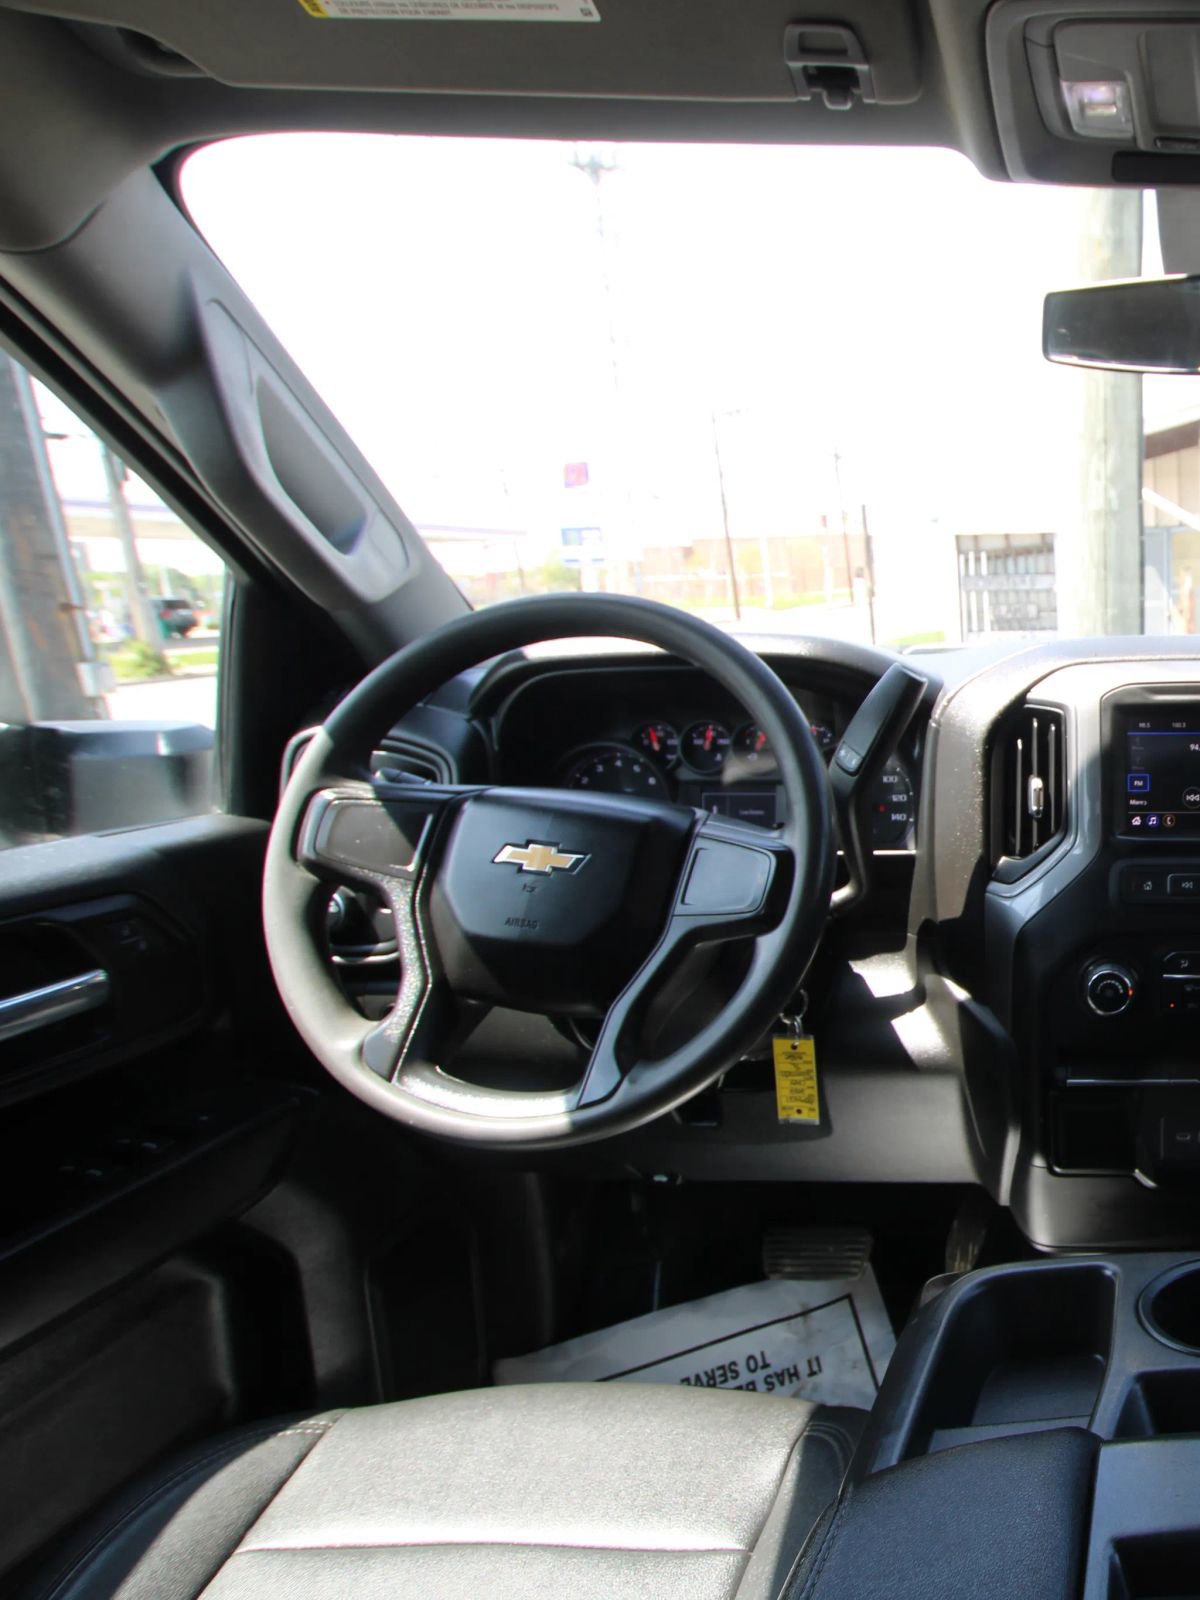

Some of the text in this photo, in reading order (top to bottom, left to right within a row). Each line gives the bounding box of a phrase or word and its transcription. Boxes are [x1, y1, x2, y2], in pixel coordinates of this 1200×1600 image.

[883, 775, 898, 783] 100
[891, 794, 907, 802] 120
[891, 813, 907, 821] 140
[747, 1350, 771, 1374] TO
[807, 1355, 824, 1378] IT
[764, 1364, 800, 1392] HAS
